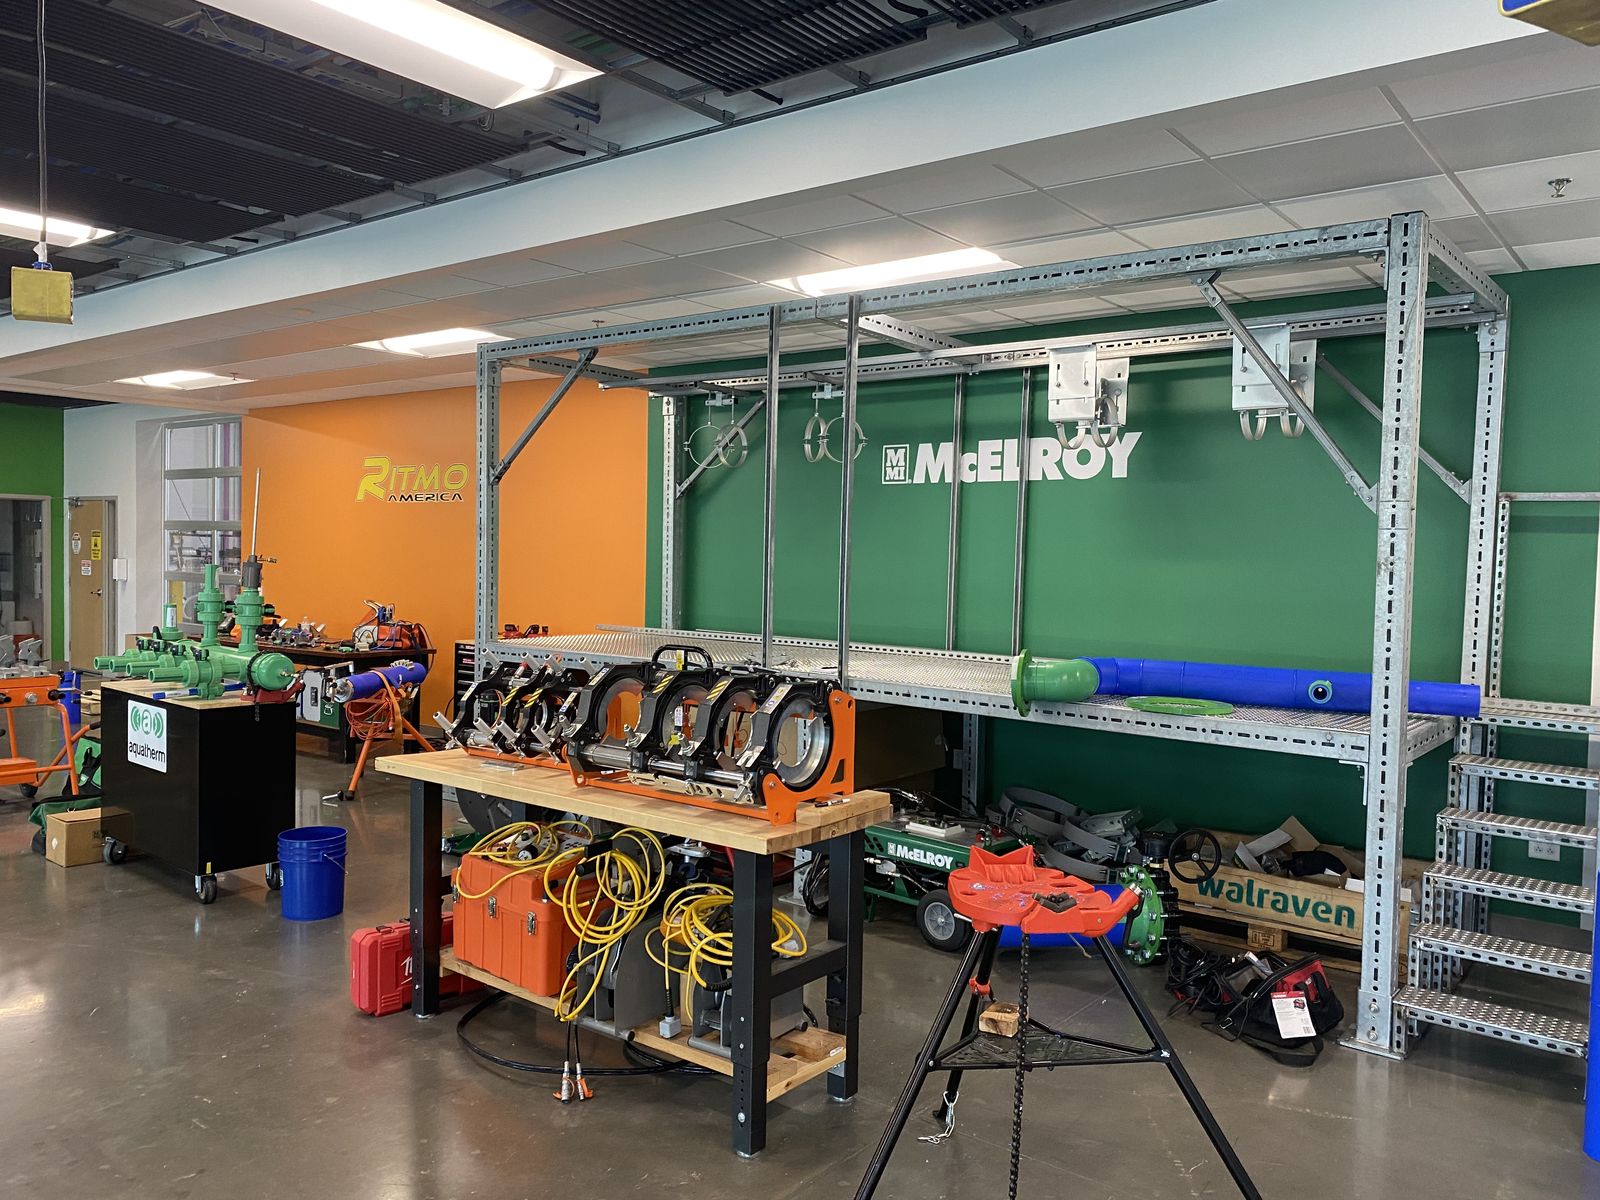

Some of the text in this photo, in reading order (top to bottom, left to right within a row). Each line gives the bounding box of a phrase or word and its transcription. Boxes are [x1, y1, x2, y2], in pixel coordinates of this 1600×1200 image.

[913, 432, 1142, 484] McELROY
[388, 492, 463, 502] AMERICA
[128, 741, 166, 763] aquatherm
[896, 844, 954, 870] McELROY
[1197, 875, 1356, 929] walraven
